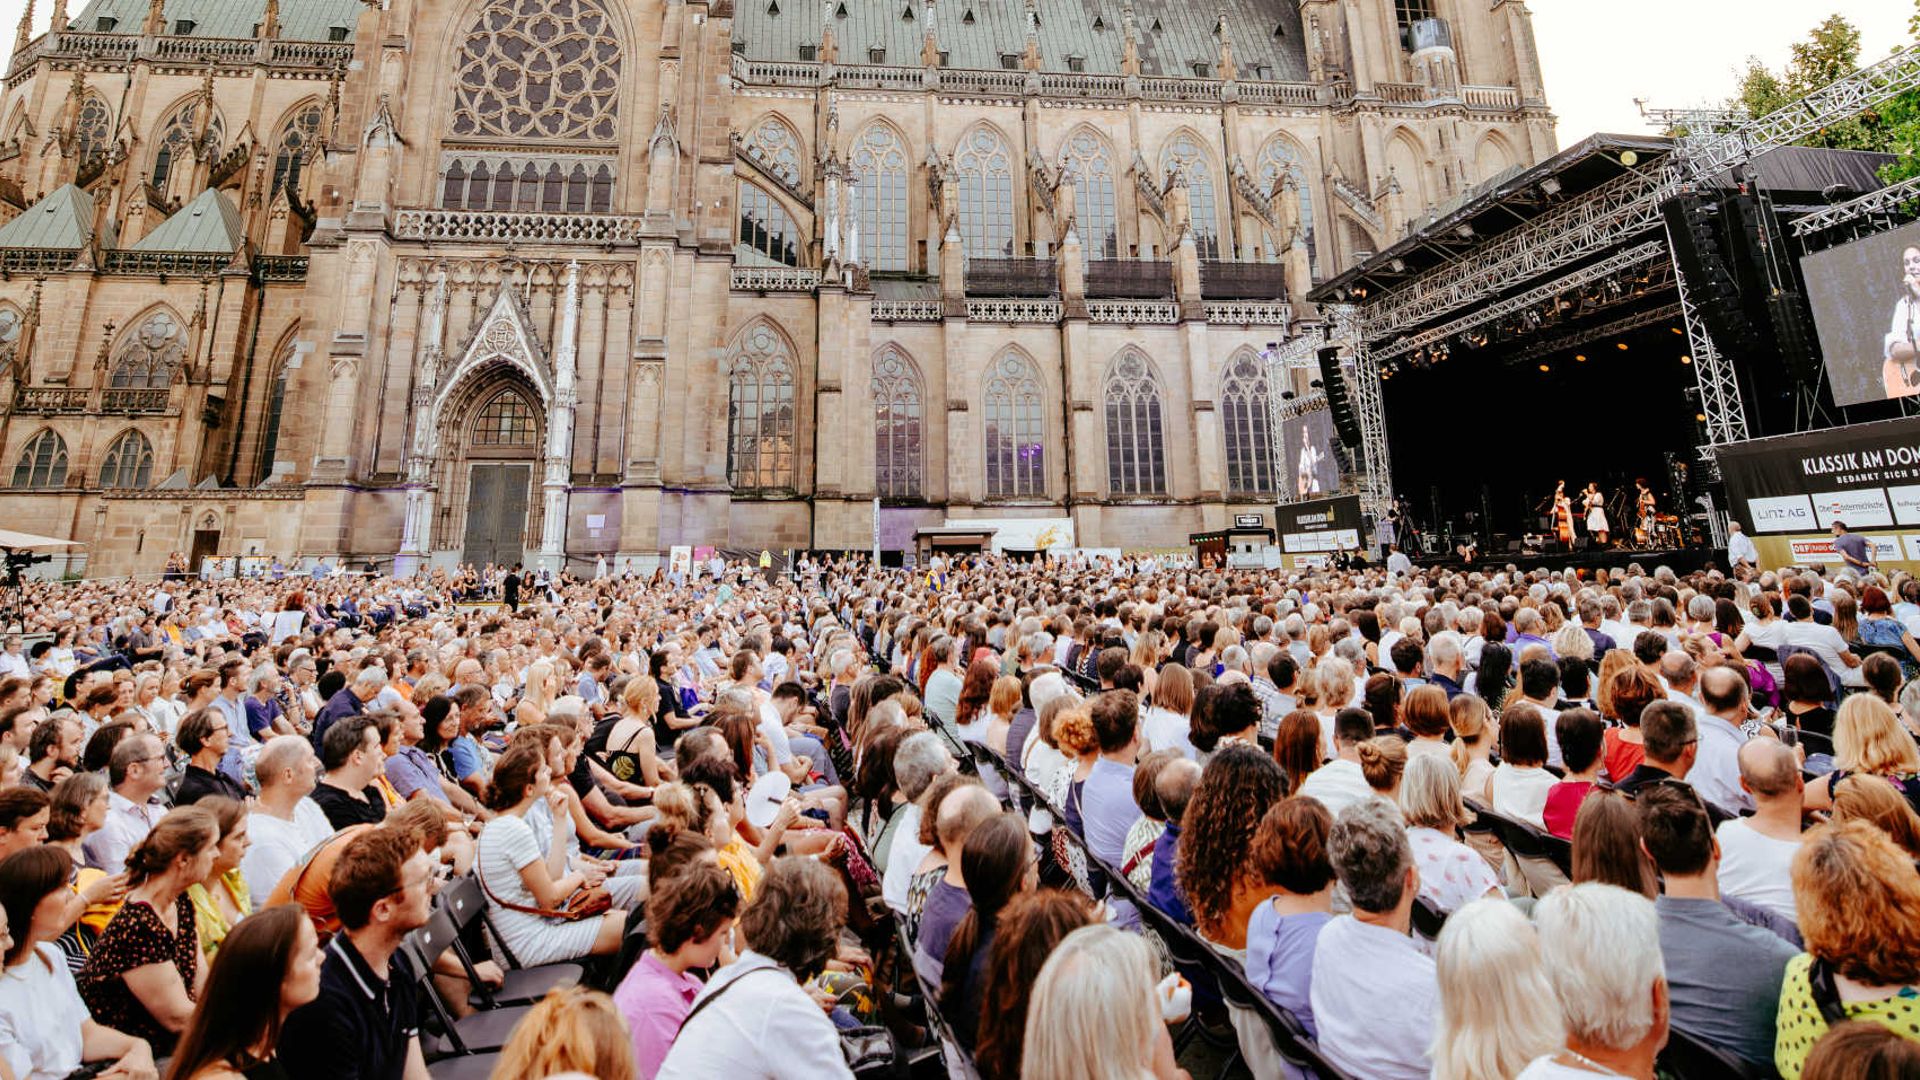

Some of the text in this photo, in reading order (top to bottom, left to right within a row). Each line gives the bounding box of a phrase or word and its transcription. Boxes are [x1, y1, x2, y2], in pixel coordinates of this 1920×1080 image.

[1802, 453, 1859, 475] KLASSIK
[1862, 450, 1884, 469] AM
[1837, 472, 1879, 484] BEDANKT
[1884, 470, 1908, 480] SICH
[1789, 508, 1806, 517] AG
